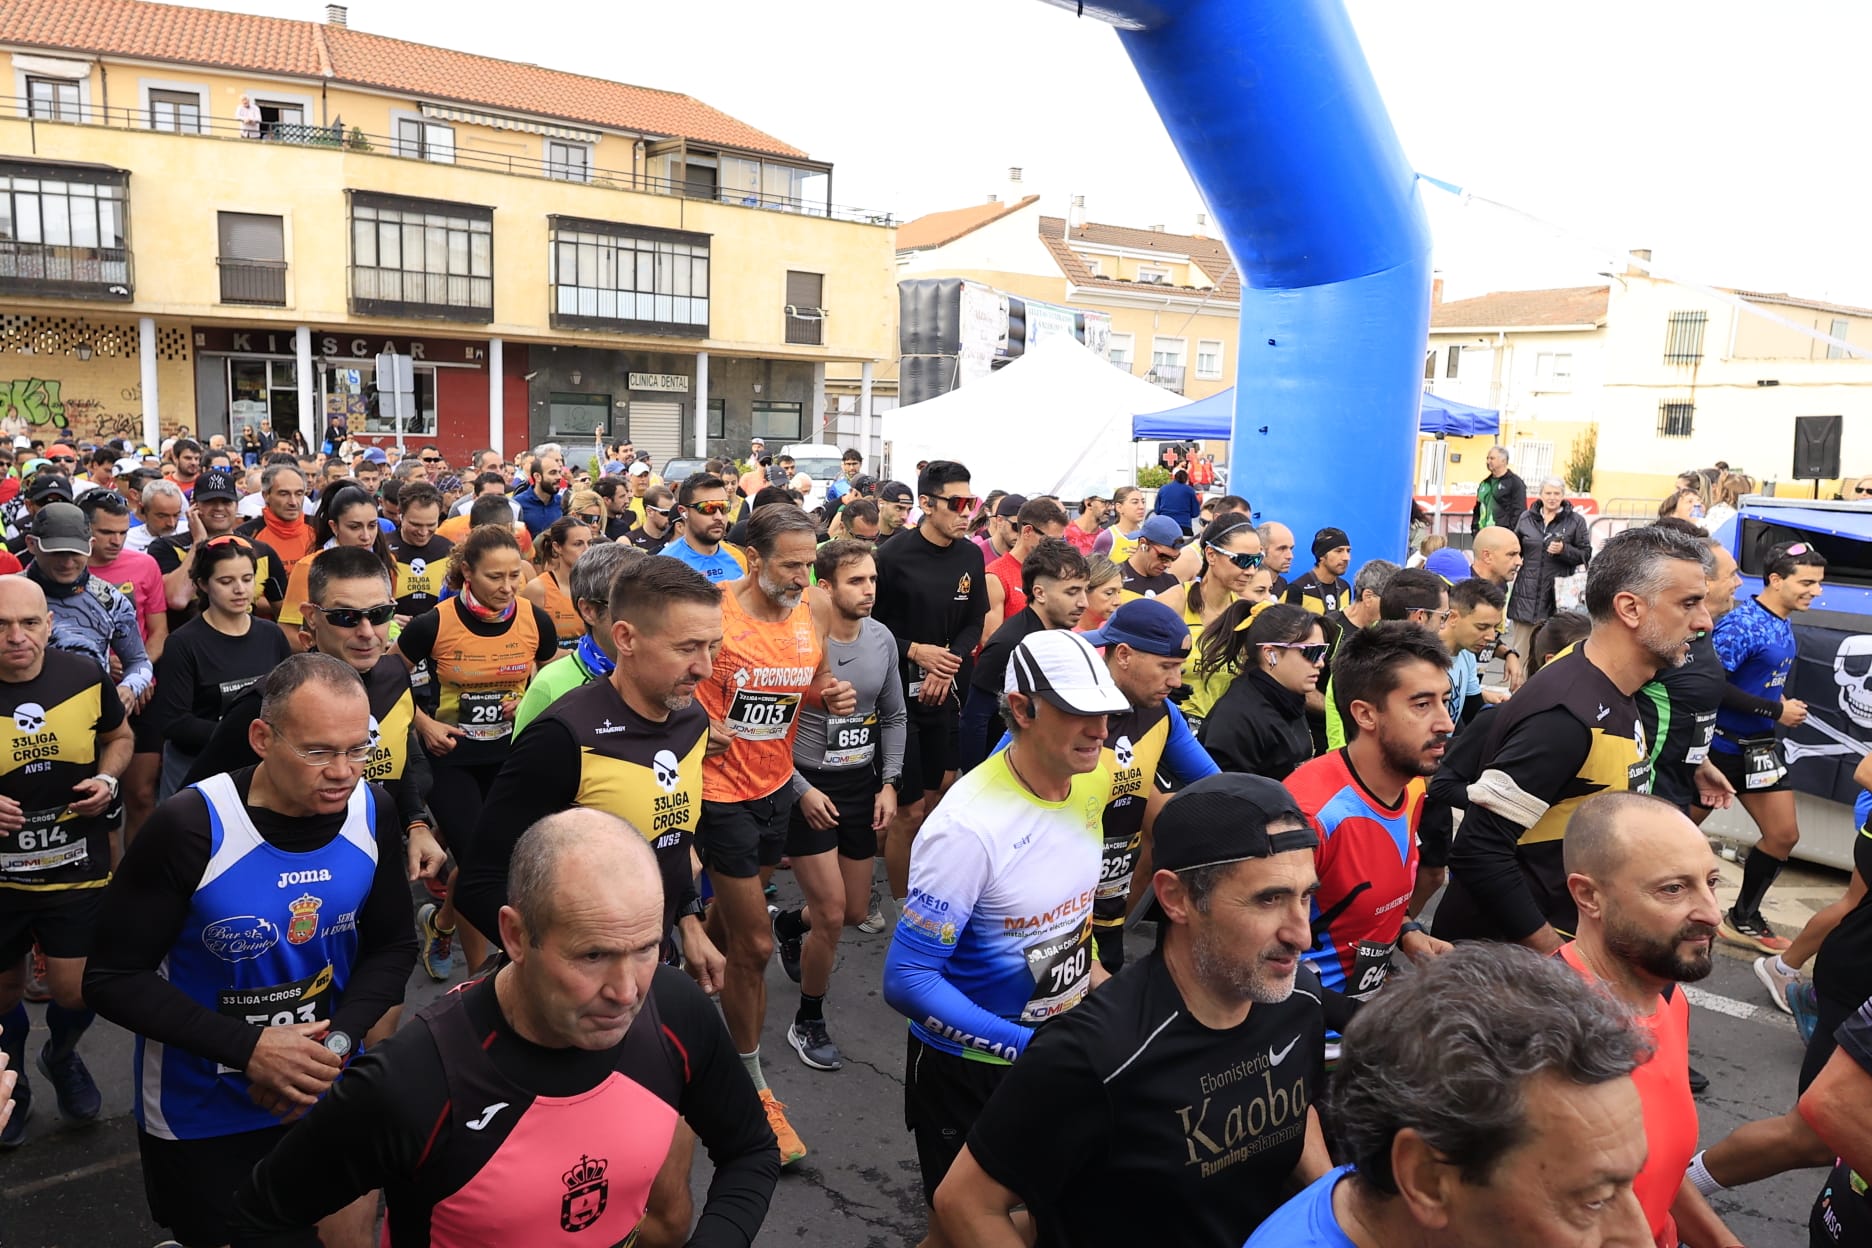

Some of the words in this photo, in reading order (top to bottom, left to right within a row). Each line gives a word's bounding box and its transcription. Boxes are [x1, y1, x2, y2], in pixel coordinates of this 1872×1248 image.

[630, 374, 658, 386] CLINICA
[661, 376, 687, 388] DENTAL
[742, 703, 786, 724] 1013
[12, 732, 58, 748] 33LIGA
[839, 728, 870, 747] 658
[13, 745, 59, 761] CROSS
[362, 762, 392, 779] ROSS
[1113, 767, 1142, 783] 33LIGA
[1112, 781, 1142, 796] CROSS
[654, 791, 690, 811] 33LIGA
[32, 813, 56, 823] CROSS
[653, 809, 690, 830] CROSS
[18, 826, 68, 850] 614
[1100, 853, 1132, 879] 625
[1050, 947, 1086, 993] 760
[222, 996, 235, 1004] 33
[237, 994, 261, 1004] LIGA
[269, 987, 302, 1002] CROSS
[923, 1015, 1017, 1062] BIKE10
[1200, 1051, 1270, 1095] Ebanisteria
[1175, 1070, 1308, 1166] Kaoba
[1823, 1205, 1842, 1240] MSC
